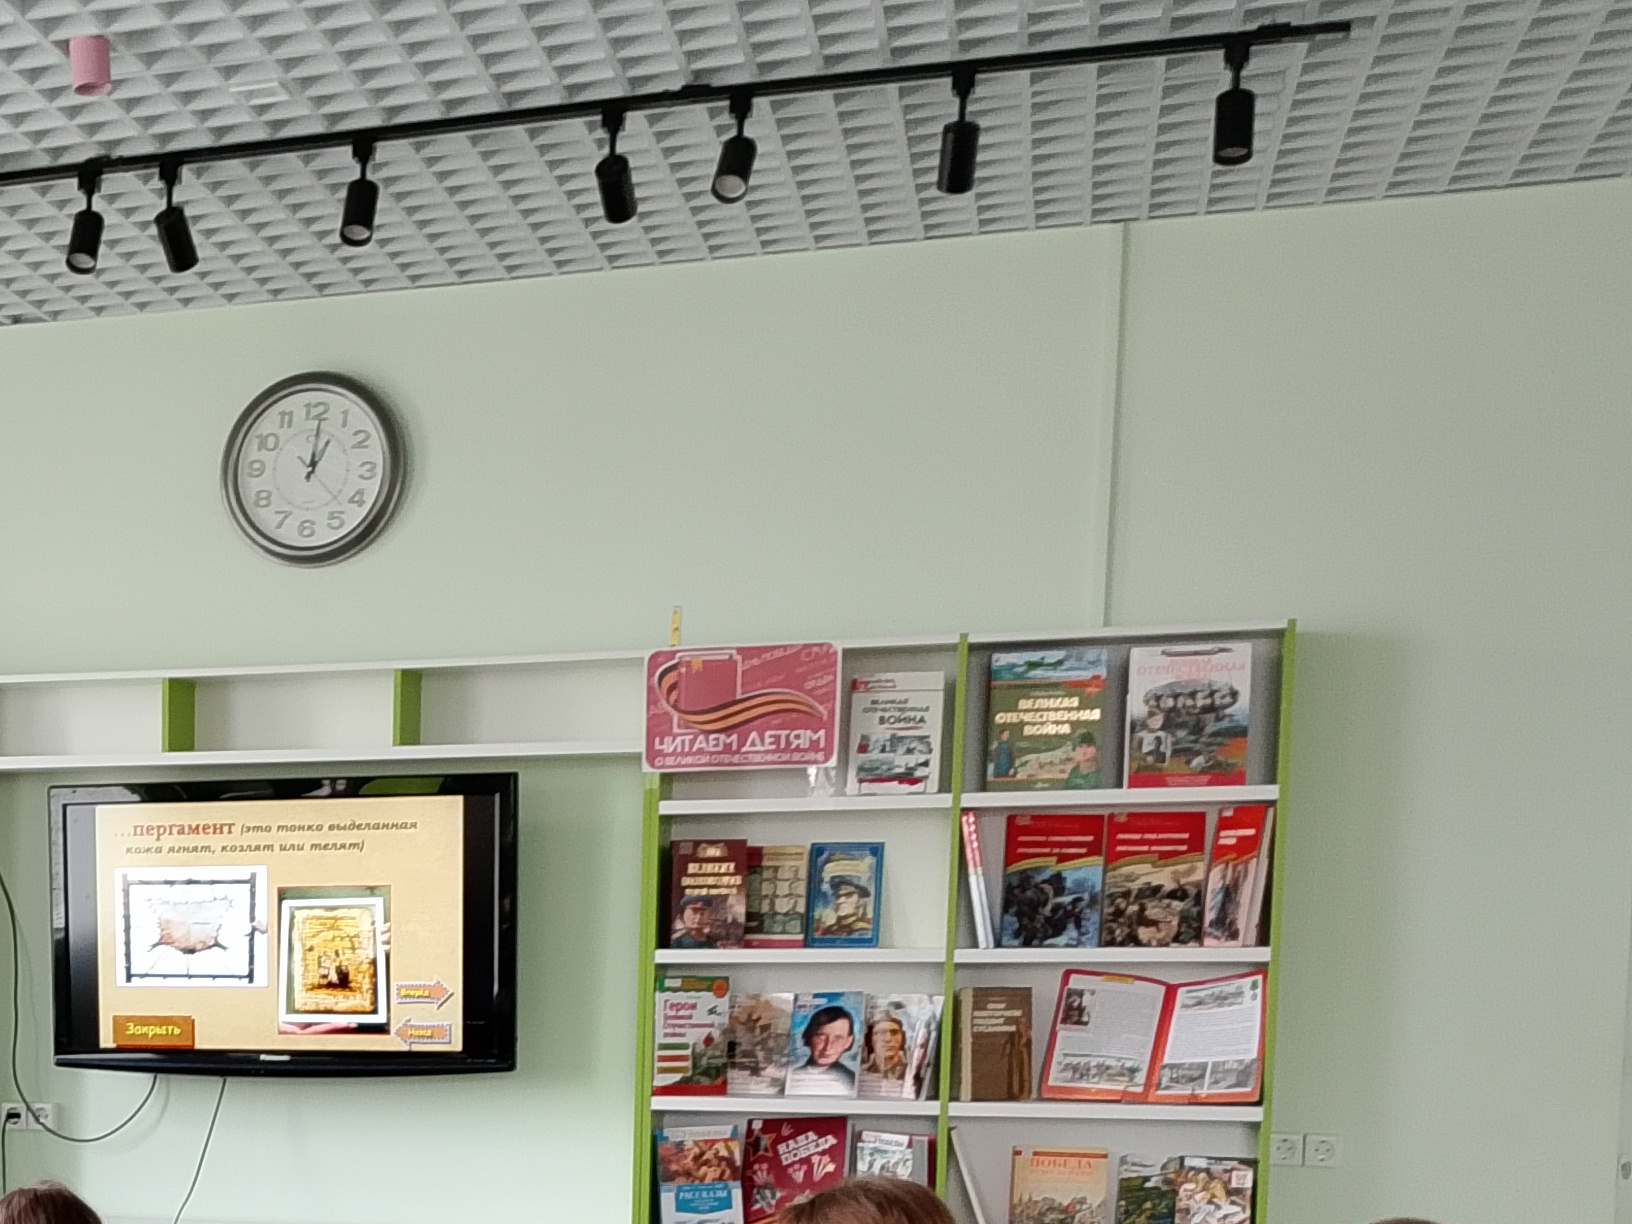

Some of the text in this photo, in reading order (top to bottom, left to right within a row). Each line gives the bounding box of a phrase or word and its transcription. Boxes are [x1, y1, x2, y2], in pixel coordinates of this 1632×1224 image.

[278, 409, 294, 429] 11
[303, 401, 331, 421] 12
[340, 408, 350, 428] 1
[255, 432, 280, 452] 10
[350, 429, 371, 449] 2
[246, 459, 266, 479] 9
[358, 460, 377, 480] 3
[254, 489, 272, 508] 8
[347, 488, 366, 507] 4
[274, 510, 293, 530] 7
[297, 519, 316, 538] 6
[326, 510, 345, 530] 5
[1018, 696, 1079, 710] ВЕЛИКАЯ
[879, 714, 927, 725] ВОЙНА
[994, 708, 1101, 724] ОТЕЧЕСТВЕННАЯ
[1023, 721, 1071, 736] ВОЙНА
[654, 729, 826, 753] ЧИТАЕМ ДЕТЯМ
[240, 823, 272, 836] (это
[276, 823, 323, 833] тонко
[327, 820, 418, 832] выделанная
[125, 840, 365, 856] кожа ягнят, козлят или телят)
[126, 1022, 181, 1038] Закрыть
